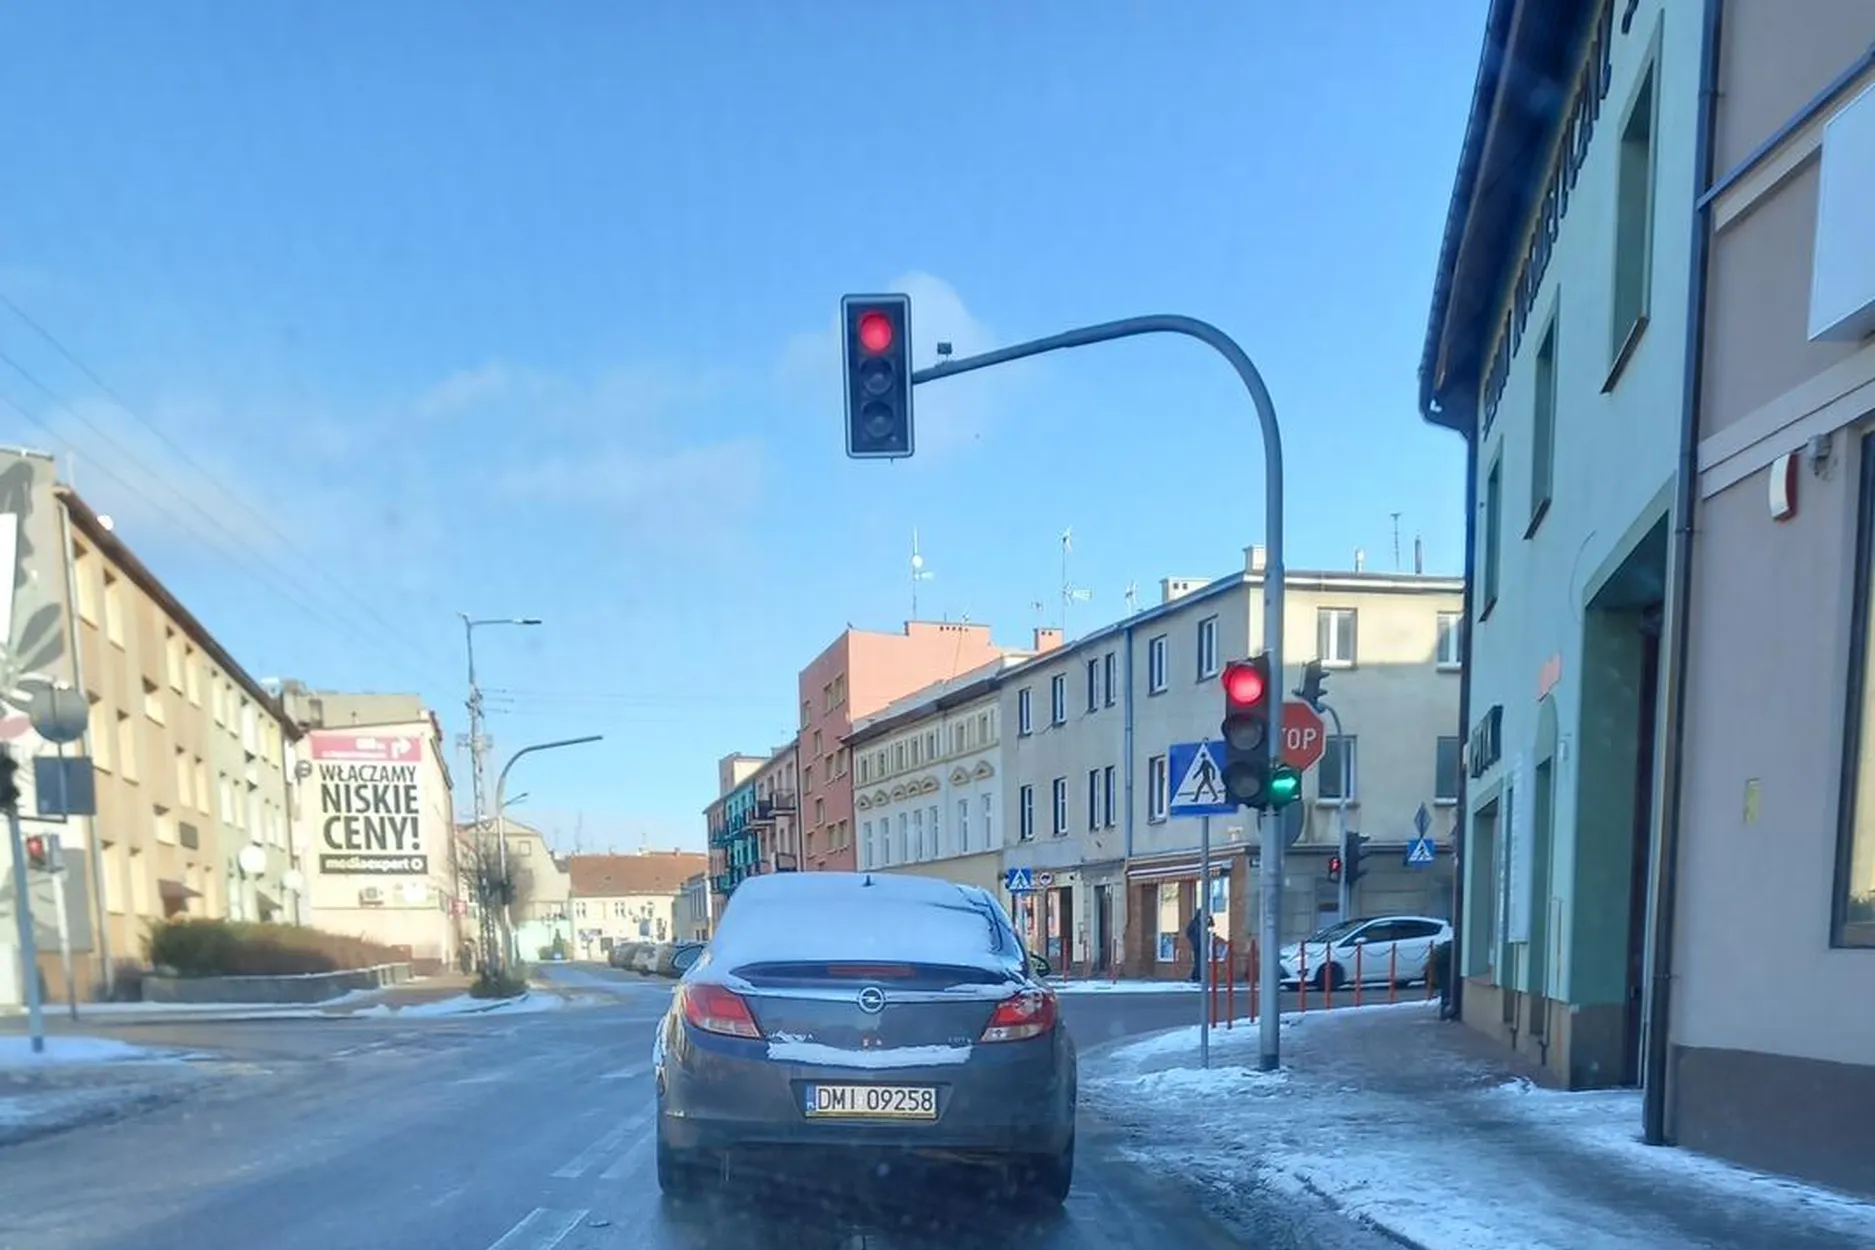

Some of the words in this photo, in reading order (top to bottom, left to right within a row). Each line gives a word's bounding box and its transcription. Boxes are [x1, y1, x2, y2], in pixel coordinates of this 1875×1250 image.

[1281, 727, 1317, 750] OP
[321, 783, 419, 814] NISKIE
[323, 815, 420, 850] CENY!
[818, 1088, 855, 1110] DMI
[867, 1089, 933, 1112] 09258
